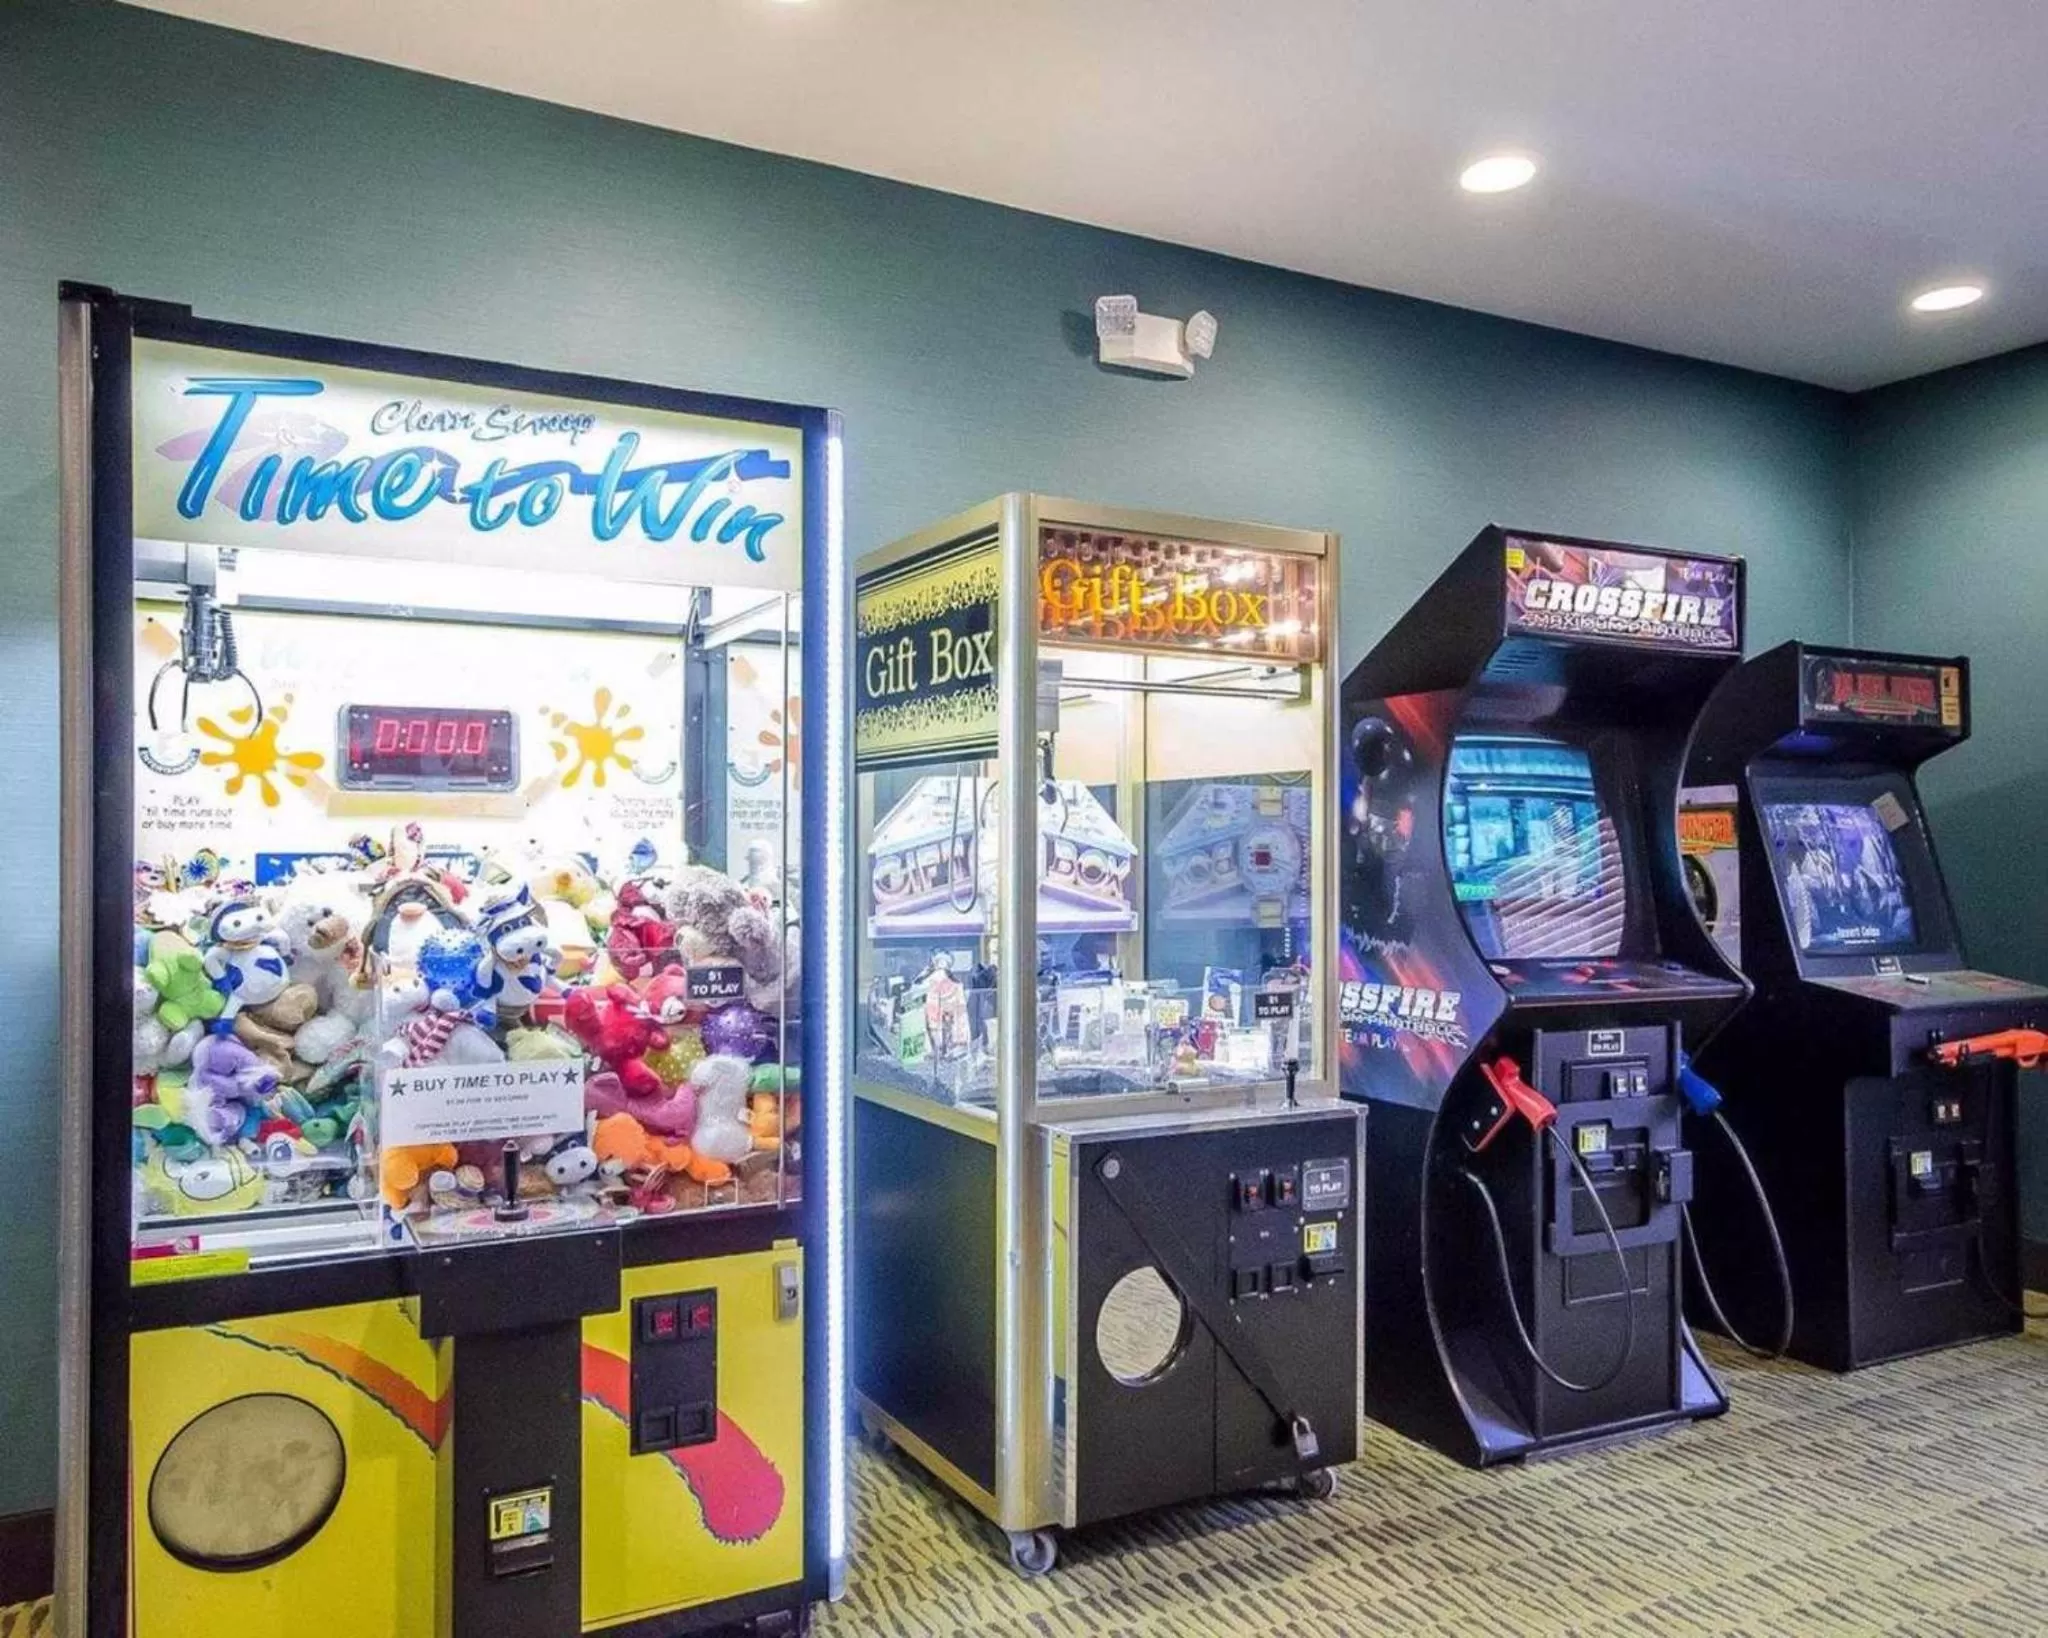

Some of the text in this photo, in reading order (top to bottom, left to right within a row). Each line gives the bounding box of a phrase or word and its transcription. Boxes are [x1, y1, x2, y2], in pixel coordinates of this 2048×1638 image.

[371, 400, 594, 445] Clean Sweep
[177, 377, 785, 563] Time to Win
[1042, 557, 1146, 617] Gift
[1173, 570, 1268, 627] Box
[1524, 578, 1726, 625] CROSSFIRE
[866, 628, 994, 698] Gift Box
[1048, 838, 1131, 898] BOX
[692, 983, 740, 995] TO PLAY
[1340, 980, 1461, 1021] SSFIRE
[413, 1070, 559, 1092] BUY TIME TO PLAY
